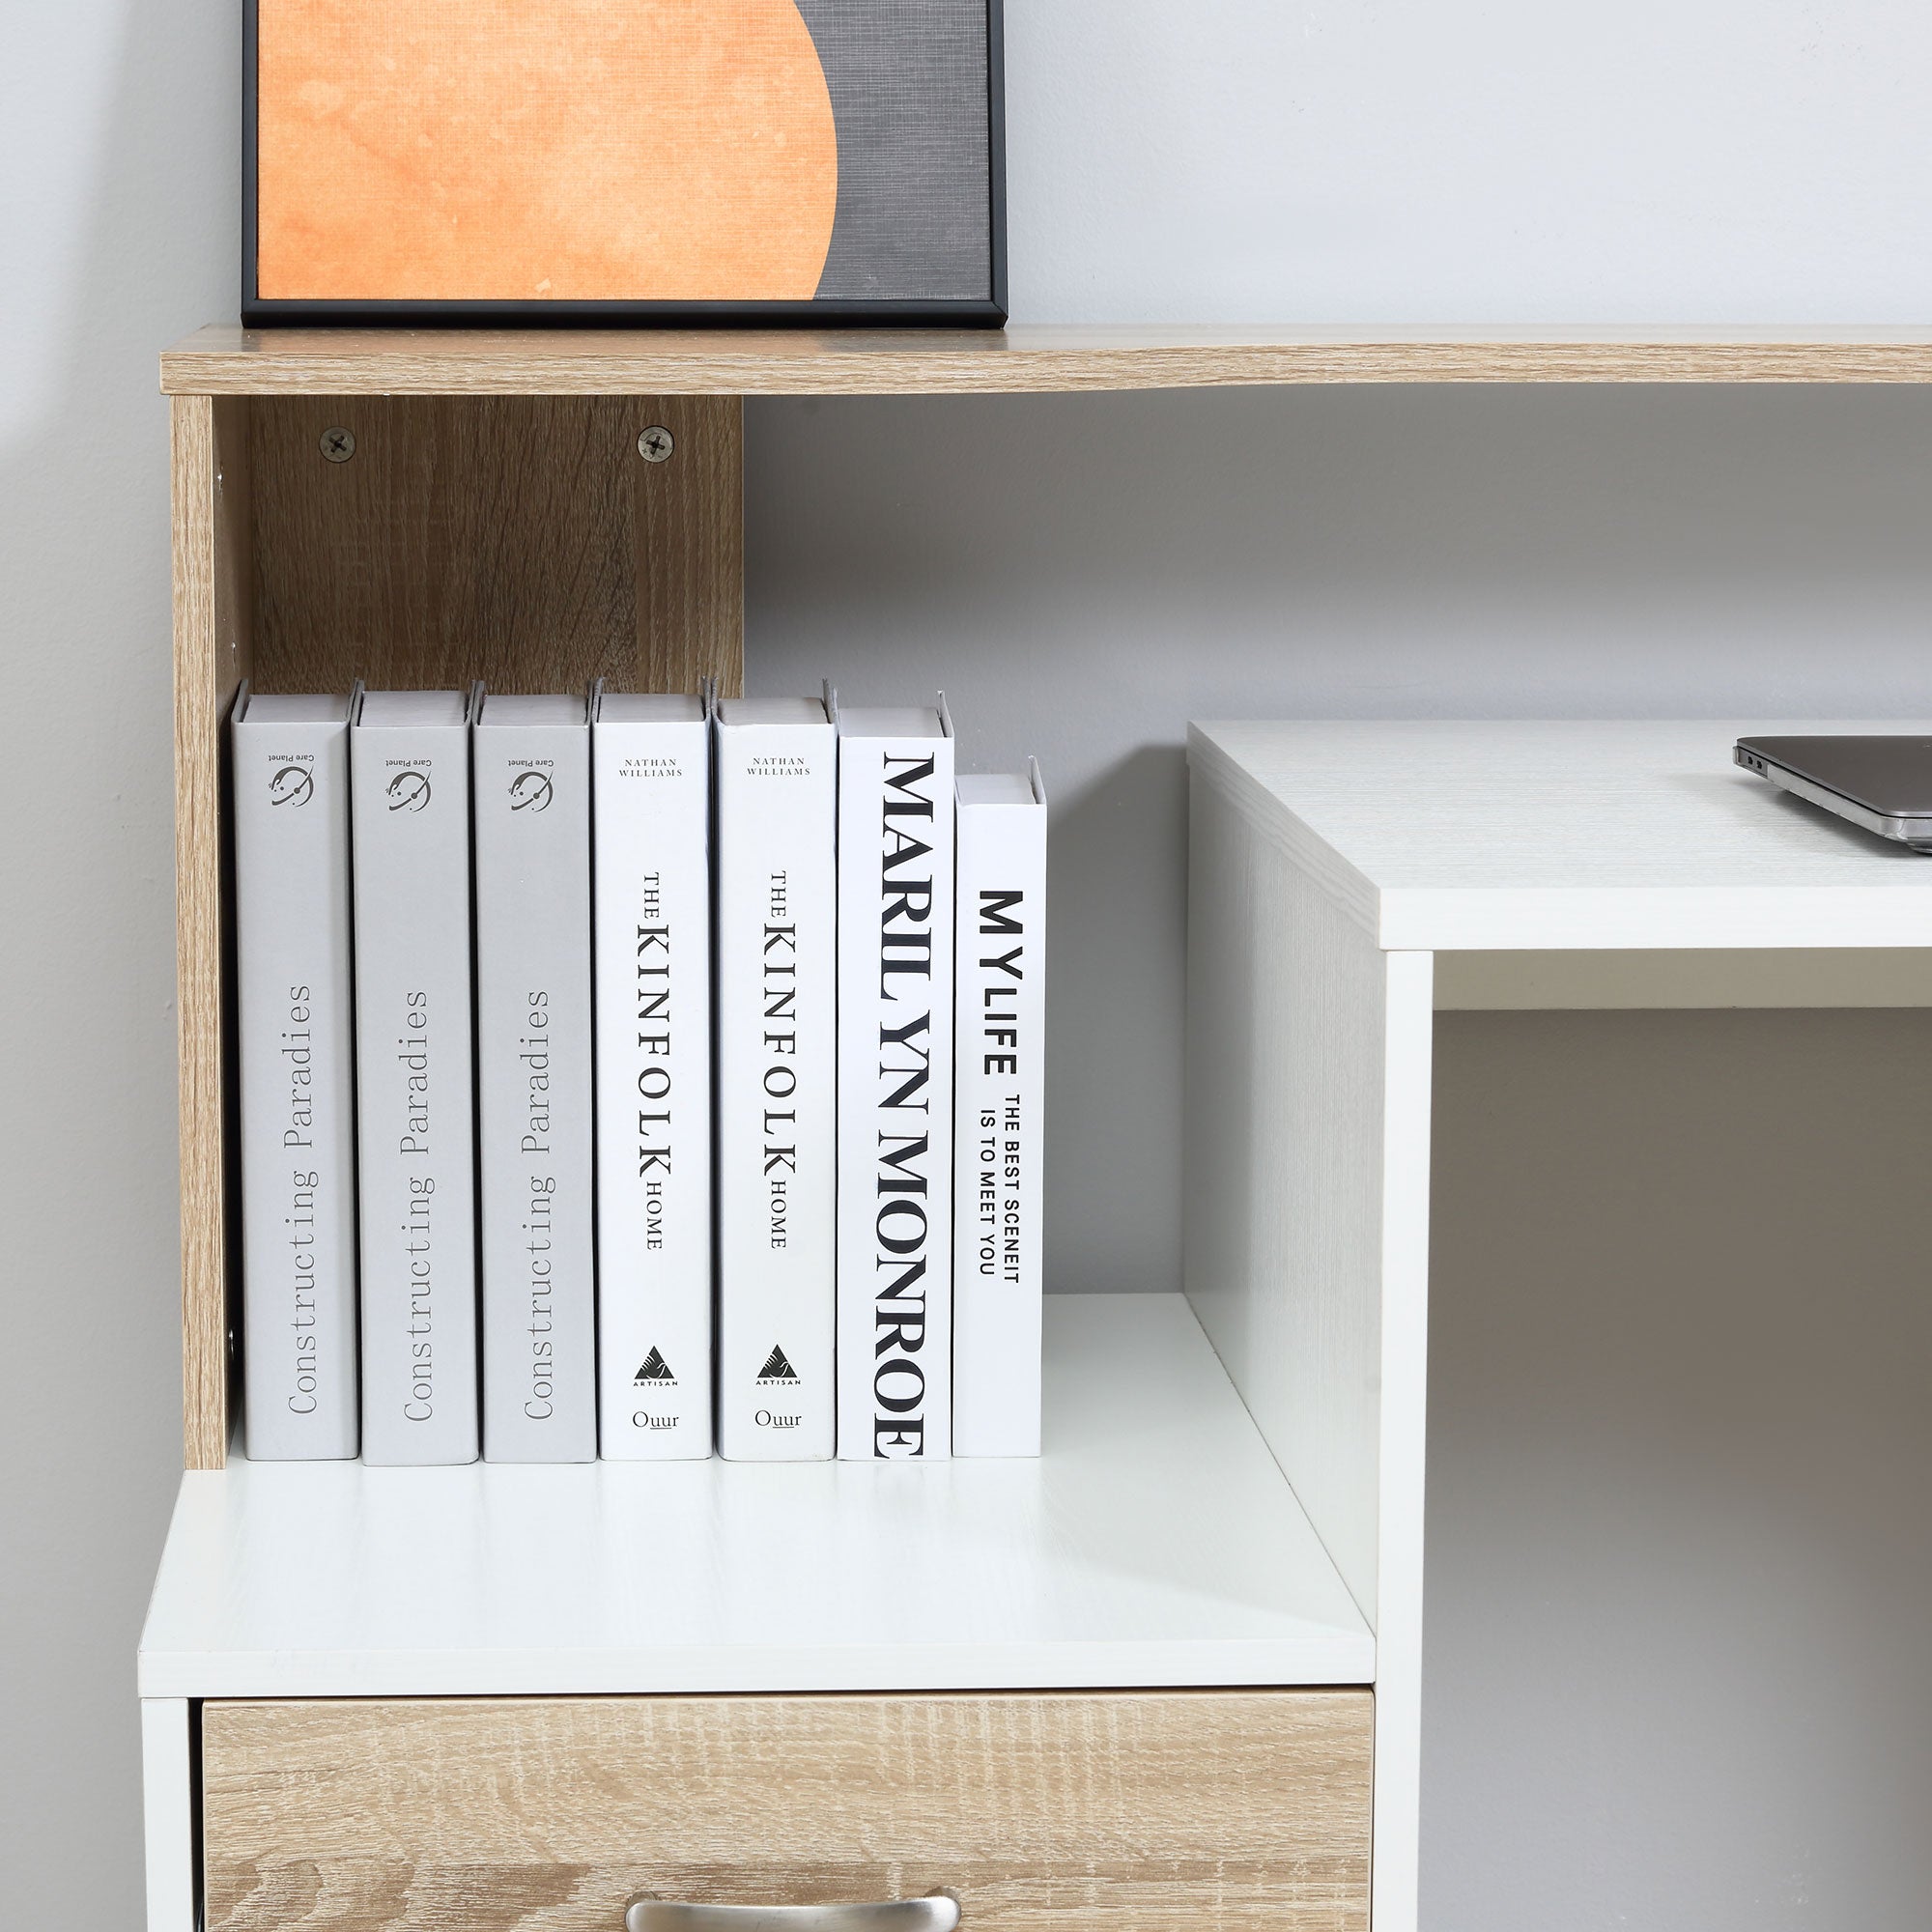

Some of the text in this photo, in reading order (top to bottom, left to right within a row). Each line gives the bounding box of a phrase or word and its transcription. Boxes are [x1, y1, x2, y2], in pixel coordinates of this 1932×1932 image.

[385, 759, 412, 768] Planet
[507, 759, 554, 768] Care Planet
[618, 769, 682, 778] WILLIAMS
[624, 758, 677, 767] NATHAN
[747, 767, 810, 776] WILLIAMS
[753, 757, 805, 766] NATHAN
[637, 871, 671, 1251] THE KINFOLK HOME
[762, 869, 797, 1250] THE KINFOLK HOME
[979, 890, 1024, 1076] MY LIFE
[281, 985, 319, 1414] Constructing Paradies
[397, 991, 436, 1422] Constructing Paradies
[519, 991, 556, 1420] Constructing Paradies
[979, 1109, 996, 1275] IS TO MEET YOU
[1004, 1094, 1021, 1284] THE BEST SCENEIT
[873, 1128, 929, 1460] MONROE
[632, 1410, 680, 1428] Ouur
[754, 1409, 803, 1427] Ouur
